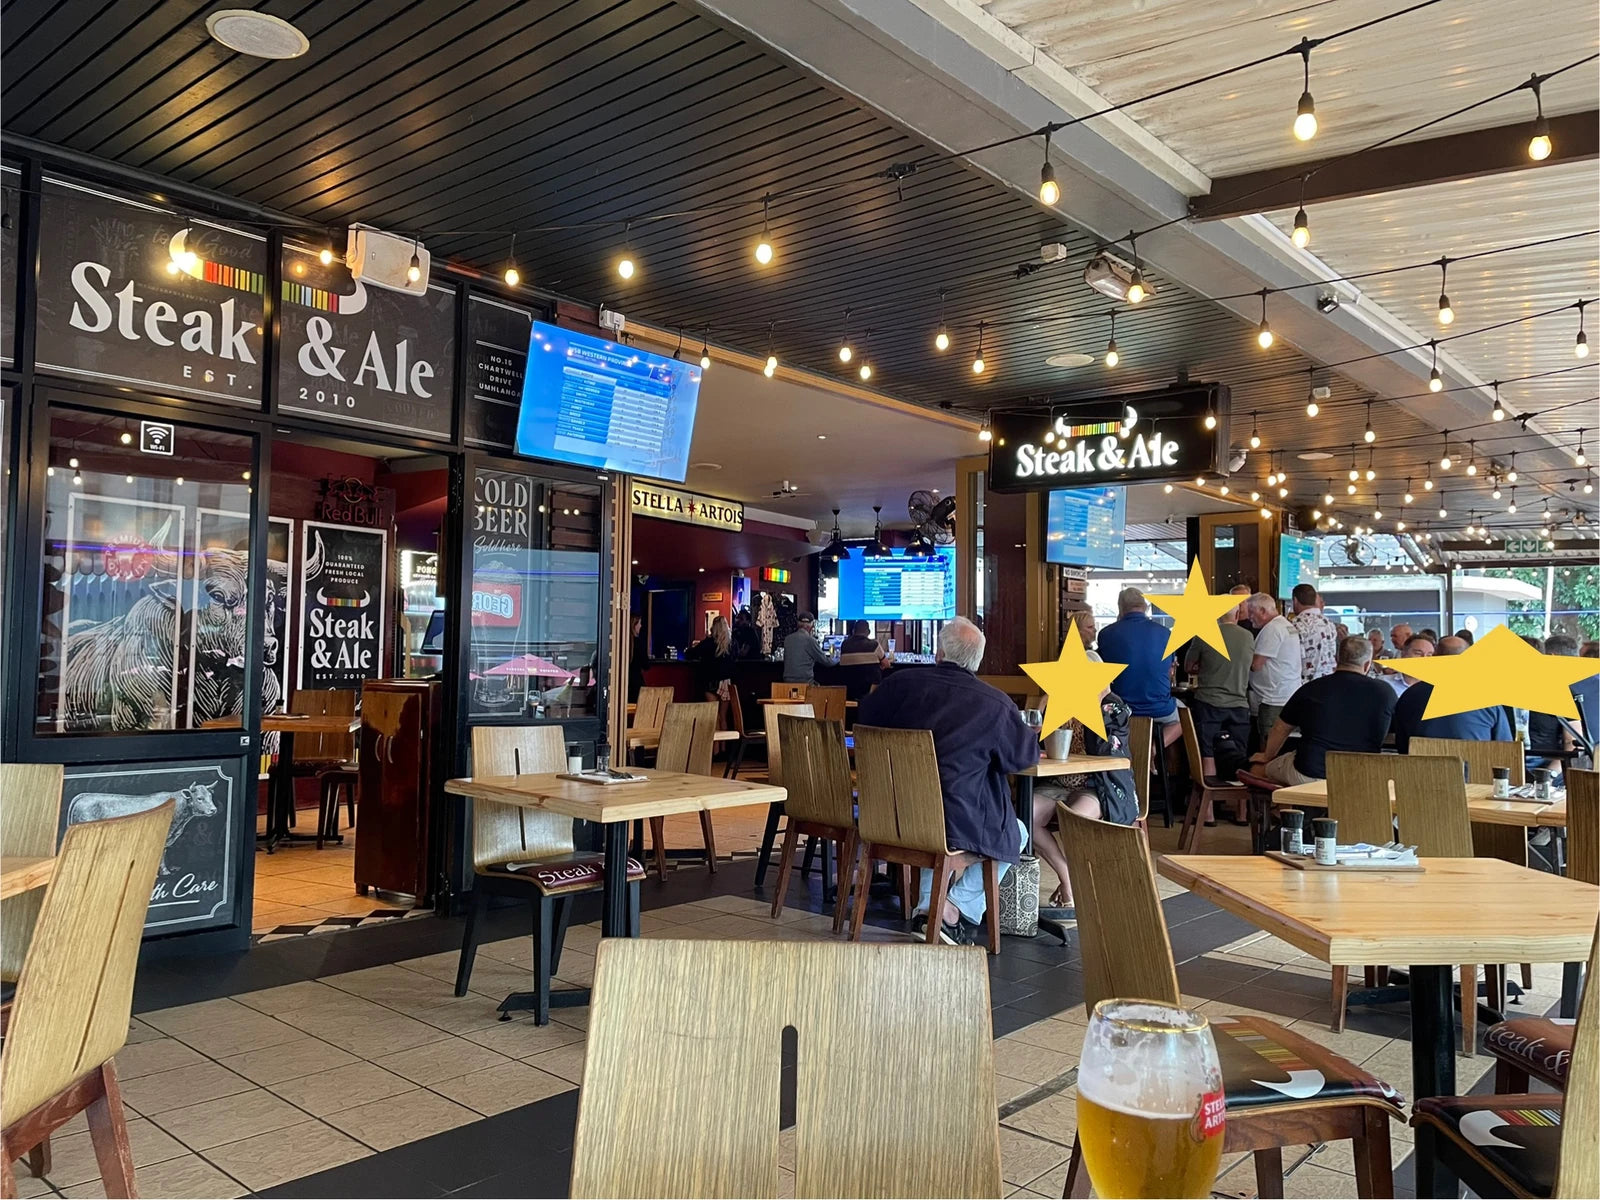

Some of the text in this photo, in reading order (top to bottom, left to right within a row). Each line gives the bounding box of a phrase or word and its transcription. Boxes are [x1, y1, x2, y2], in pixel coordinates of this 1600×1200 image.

[69, 261, 435, 399] Steak & Ale
[183, 365, 356, 408] EST. 2010
[489, 375, 512, 386] DRIVE
[1016, 432, 1180, 477] Steak & Ale
[322, 501, 382, 525] Red Bull
[632, 489, 743, 525] STELLA ARTOIS
[325, 561, 365, 570] GUARANTEED
[309, 607, 374, 640] Steak
[310, 639, 372, 670] & Ale
[172, 873, 219, 898] Care
[538, 863, 598, 886] Steak
[1489, 1025, 1547, 1060] teak
